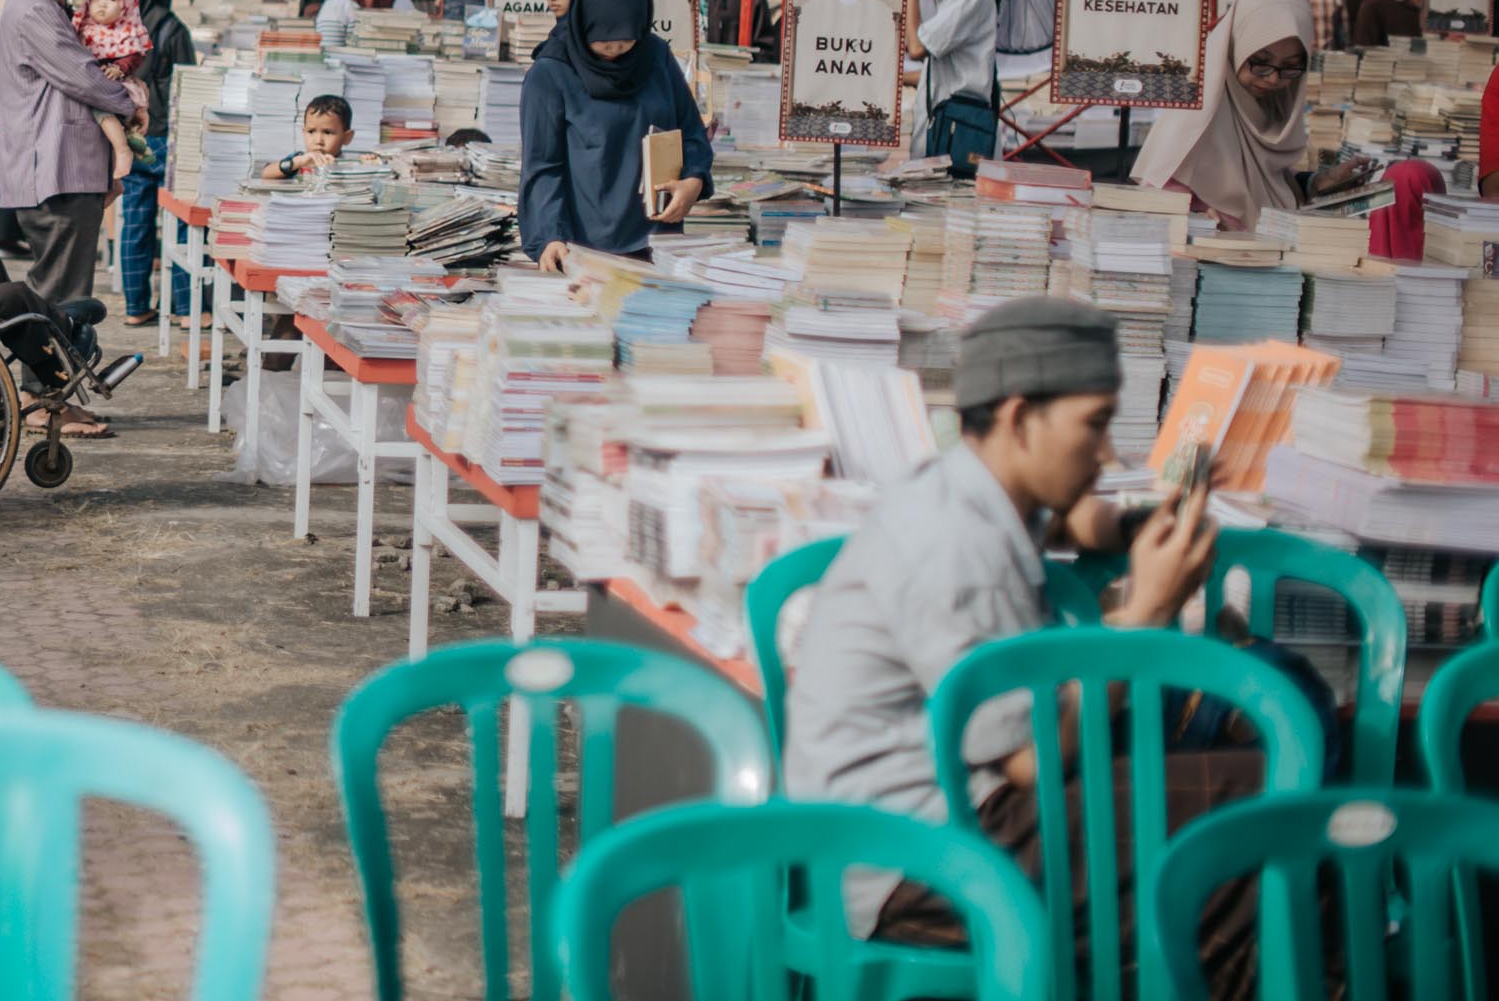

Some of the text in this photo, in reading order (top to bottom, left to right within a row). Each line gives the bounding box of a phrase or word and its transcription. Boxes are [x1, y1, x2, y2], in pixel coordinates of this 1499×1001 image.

[1084, 0, 1179, 15] KESEHATAN
[816, 36, 873, 53] BUKU
[815, 59, 873, 76] ANAK
